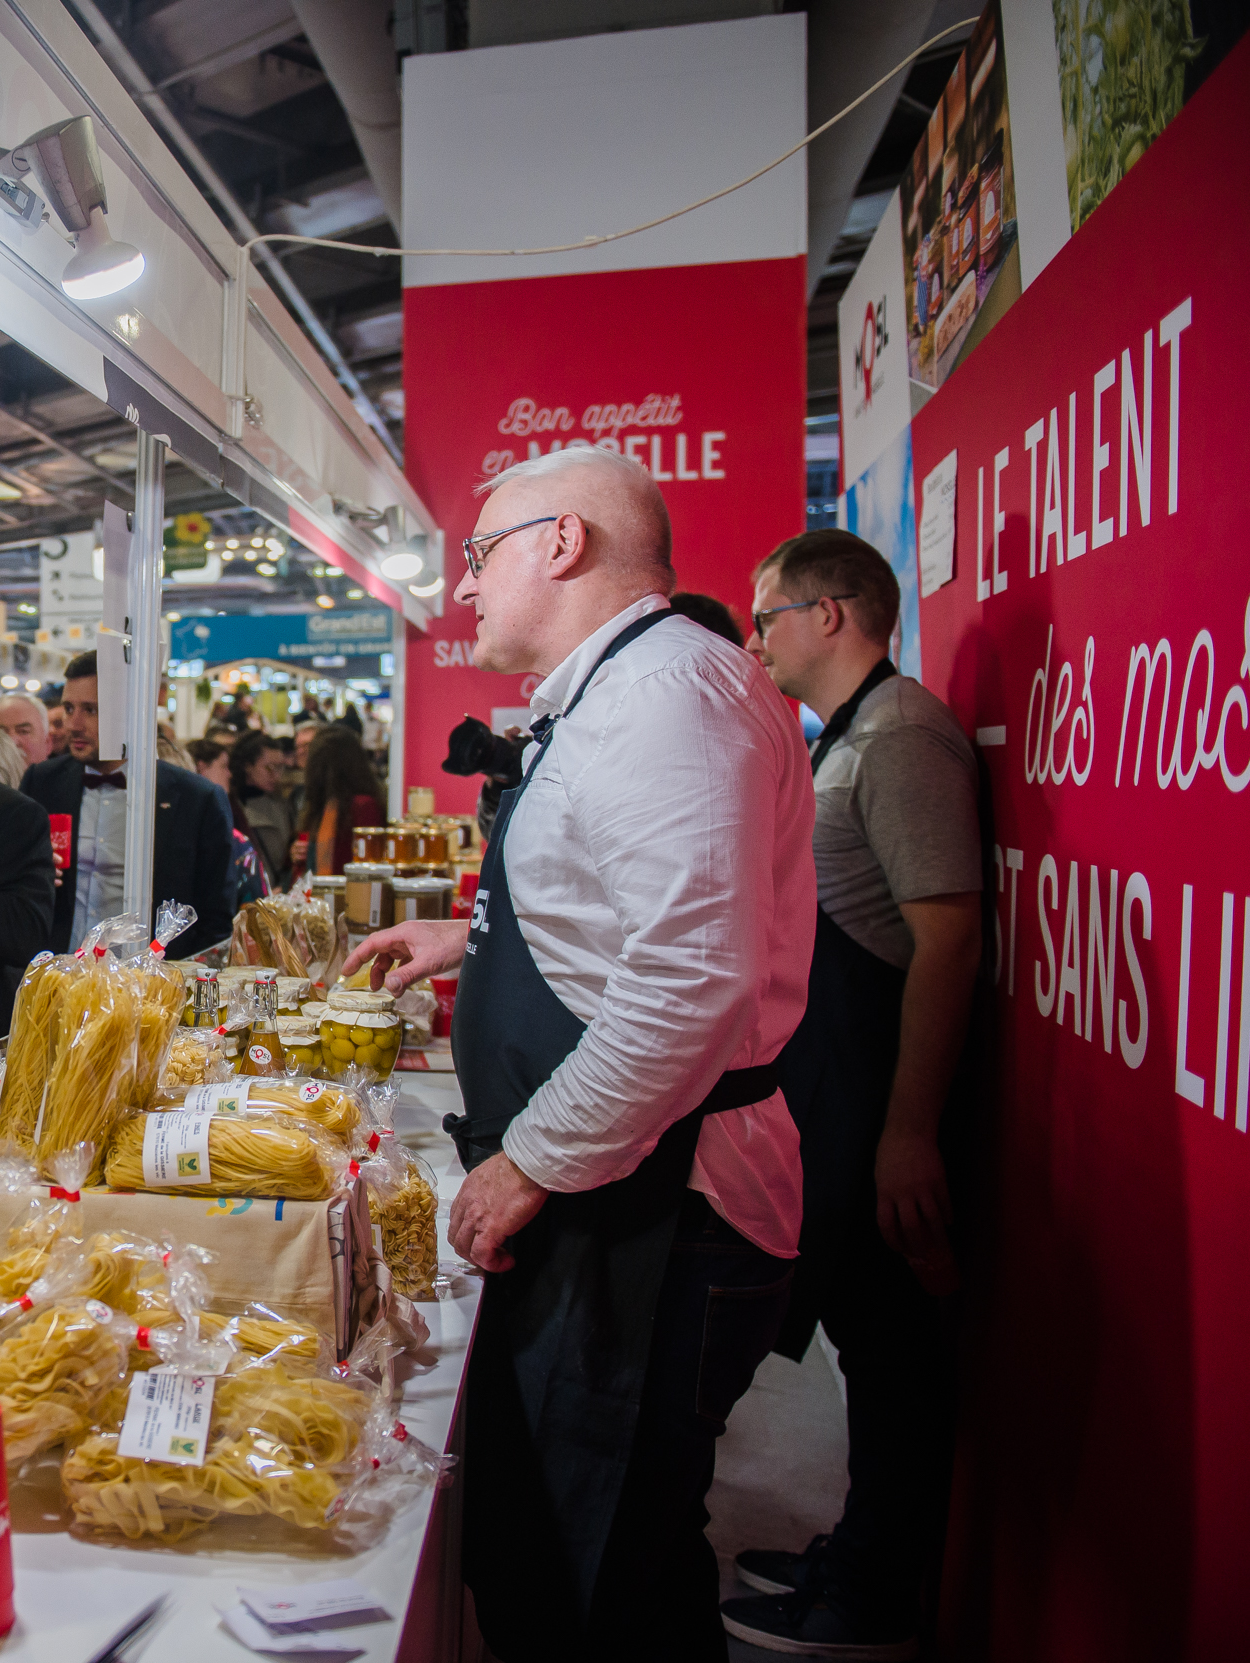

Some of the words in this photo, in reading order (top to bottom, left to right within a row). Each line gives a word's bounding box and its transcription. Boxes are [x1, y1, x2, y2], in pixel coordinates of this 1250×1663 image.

[497, 397, 576, 437] Bon
[581, 393, 684, 438] appétit
[526, 431, 727, 482] ELLE
[976, 446, 1009, 602] LE
[1024, 295, 1192, 578] TALENT
[433, 639, 478, 668] SAV
[1024, 623, 1095, 787] des
[1034, 853, 1152, 1070] SANS
[1174, 883, 1250, 1135] LI
[250, 1047, 271, 1061] MOSL
